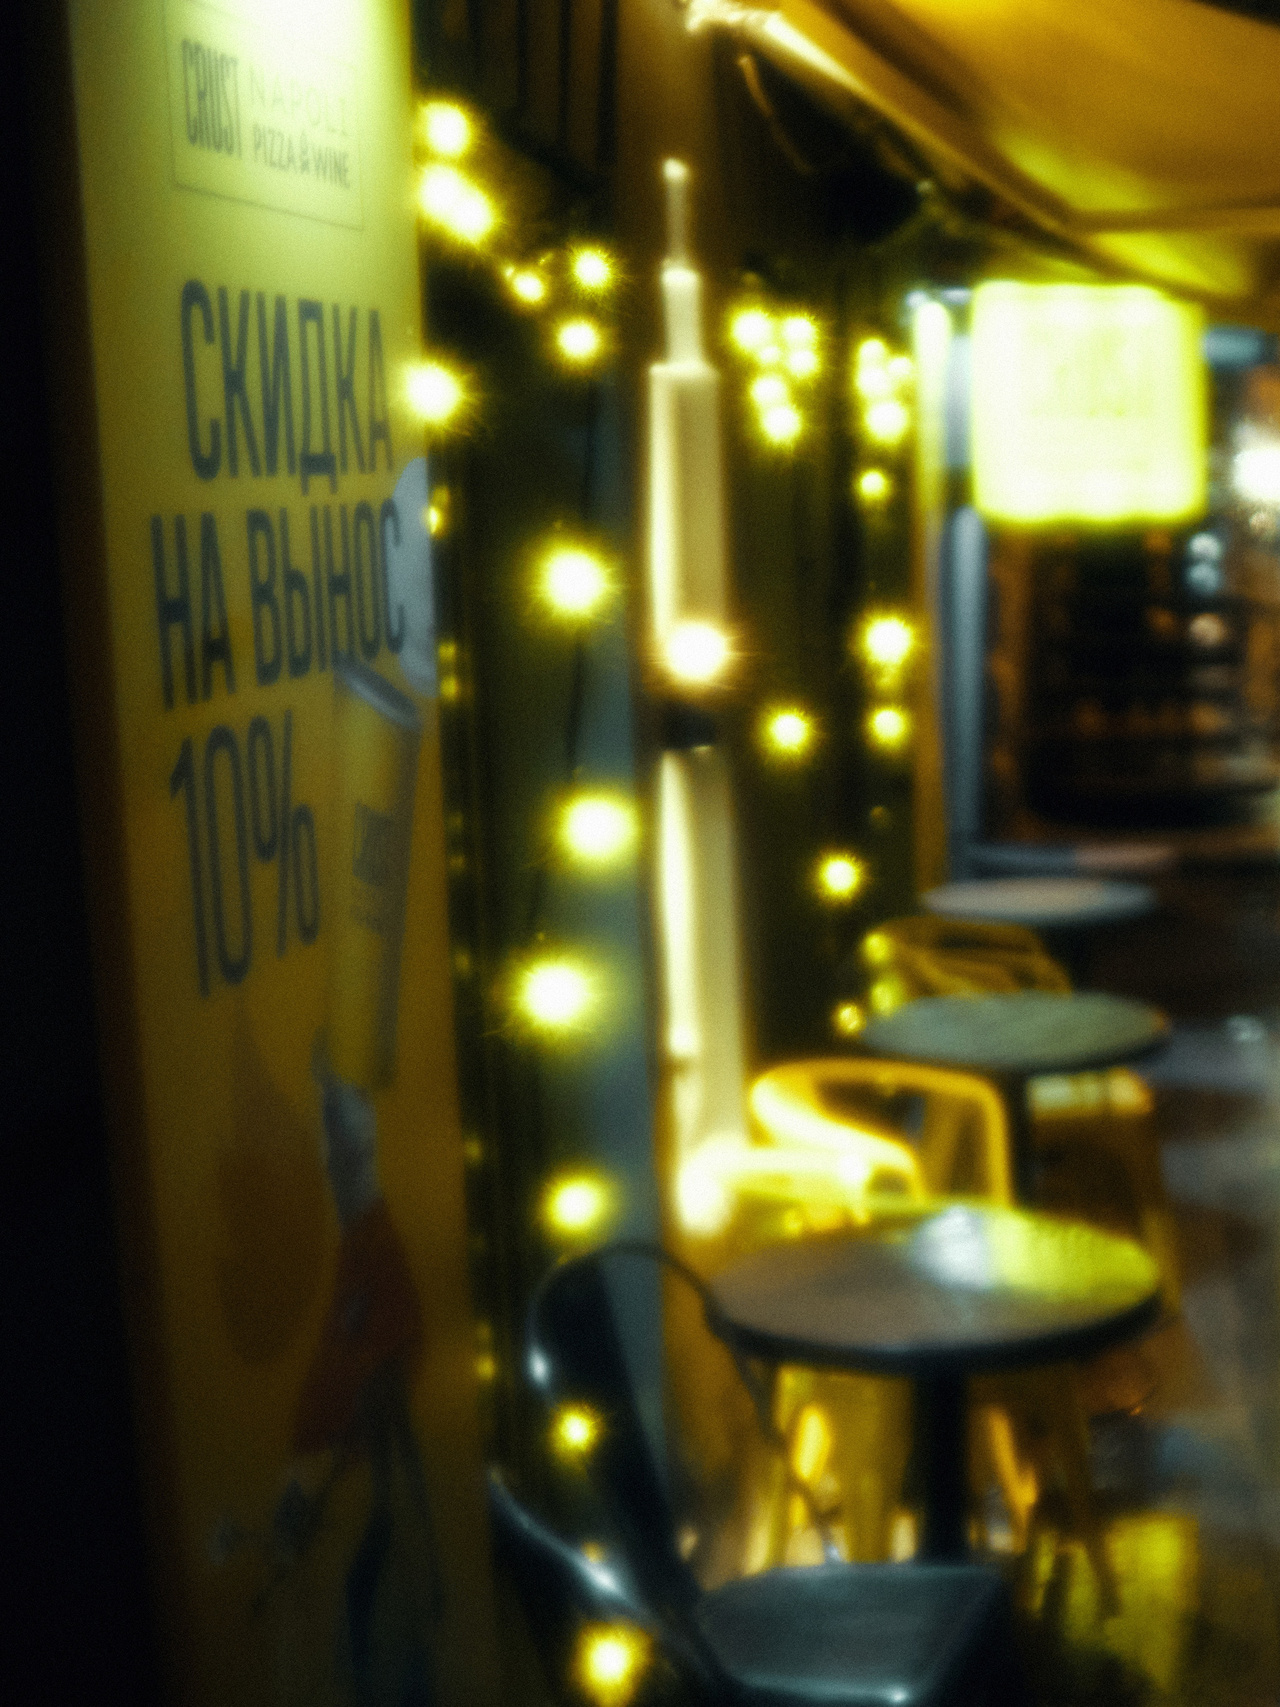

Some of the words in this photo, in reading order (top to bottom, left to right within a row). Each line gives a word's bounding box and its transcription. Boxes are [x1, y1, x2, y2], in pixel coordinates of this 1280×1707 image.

[181, 39, 242, 159] CRUST
[252, 123, 297, 173] PIZZA
[312, 143, 351, 189] WINE
[180, 280, 395, 496] СКИДКА
[150, 513, 236, 711] НА
[247, 500, 404, 687] ВЫНОС
[169, 708, 320, 999] 10%
